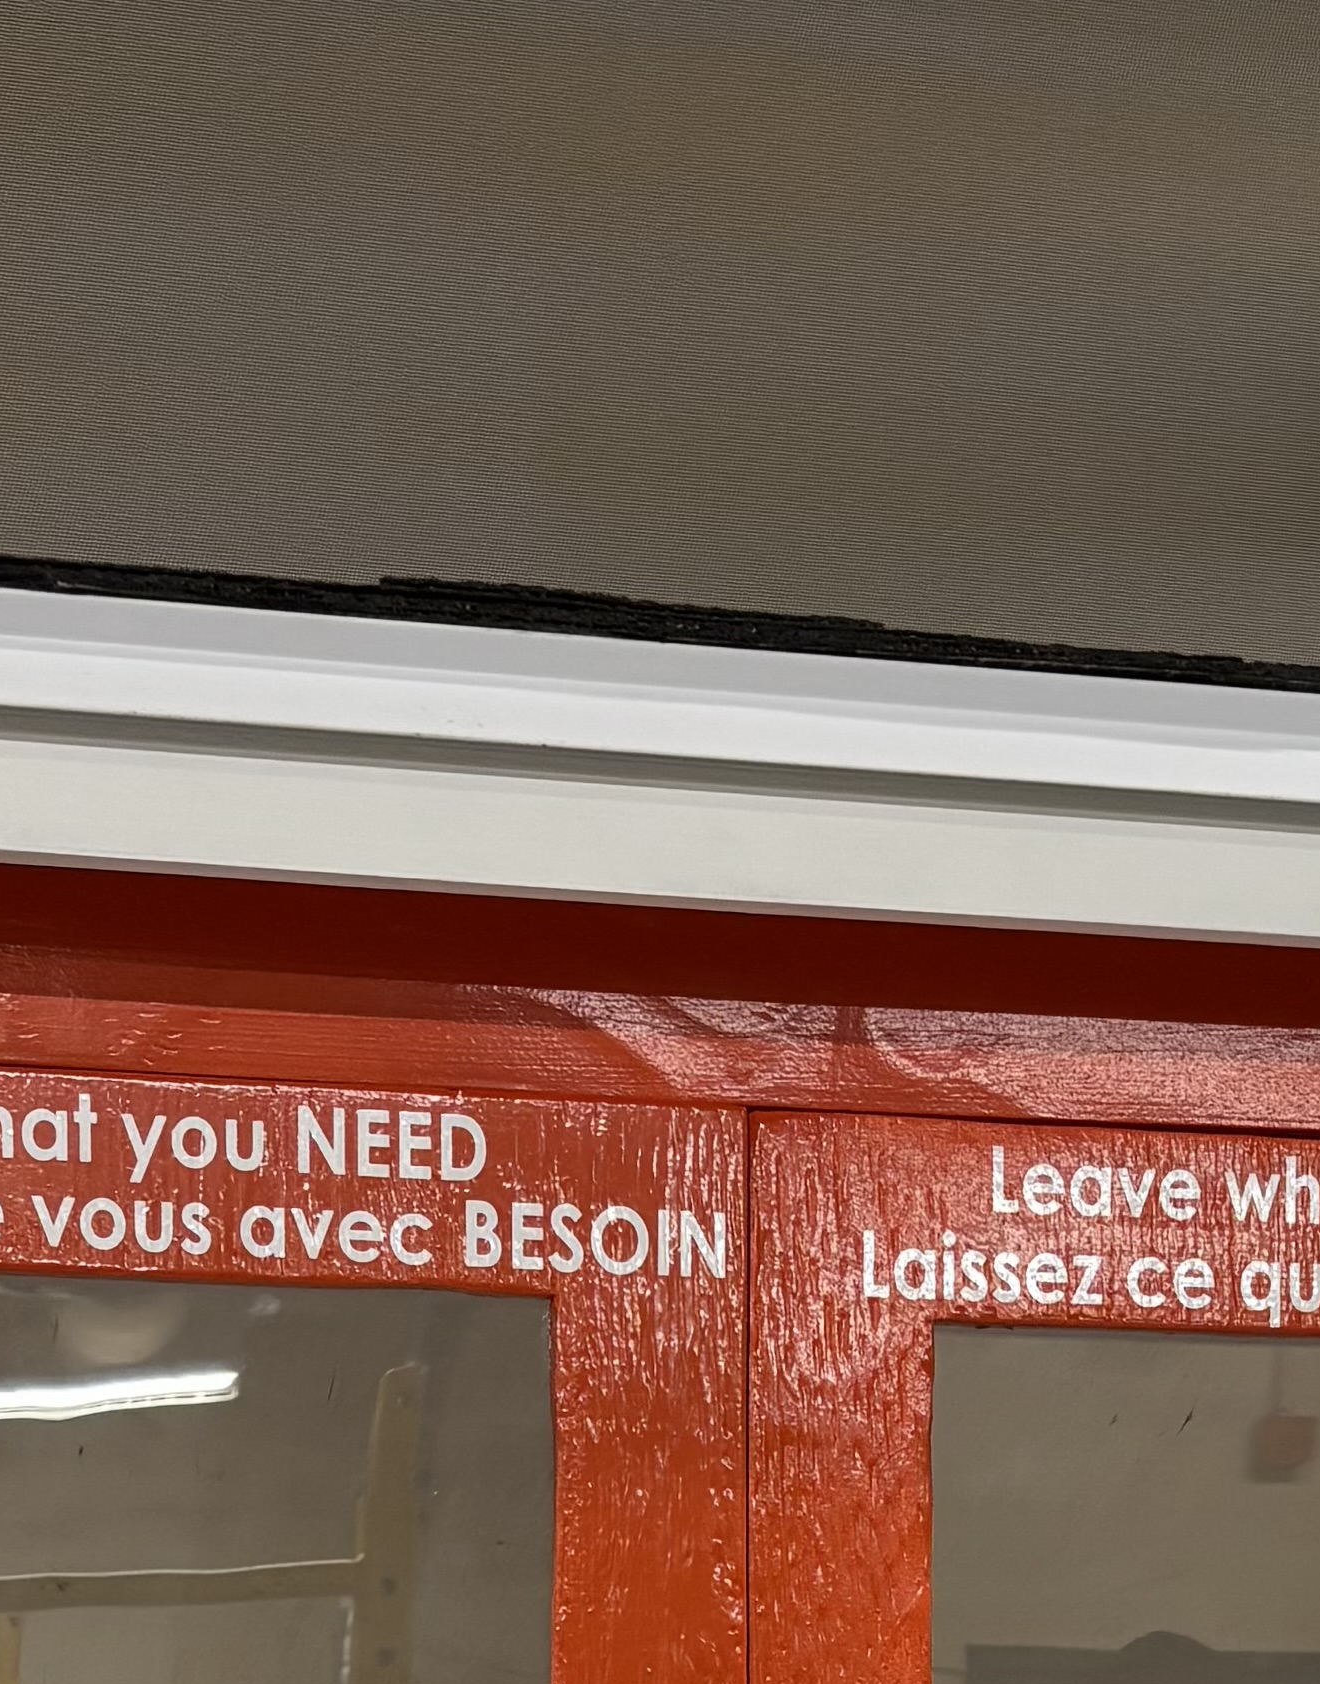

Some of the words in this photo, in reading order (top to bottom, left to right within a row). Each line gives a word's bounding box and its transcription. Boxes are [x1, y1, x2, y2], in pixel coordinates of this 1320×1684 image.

[120, 1112, 270, 1184] you
[297, 1104, 488, 1182] NEED
[991, 1145, 1202, 1222] Leave
[31, 1195, 213, 1256] vous
[239, 1205, 434, 1266] avec
[462, 1199, 727, 1279] BESOIN
[860, 1228, 1108, 1306] Laissez
[1123, 1252, 1215, 1310] ce
